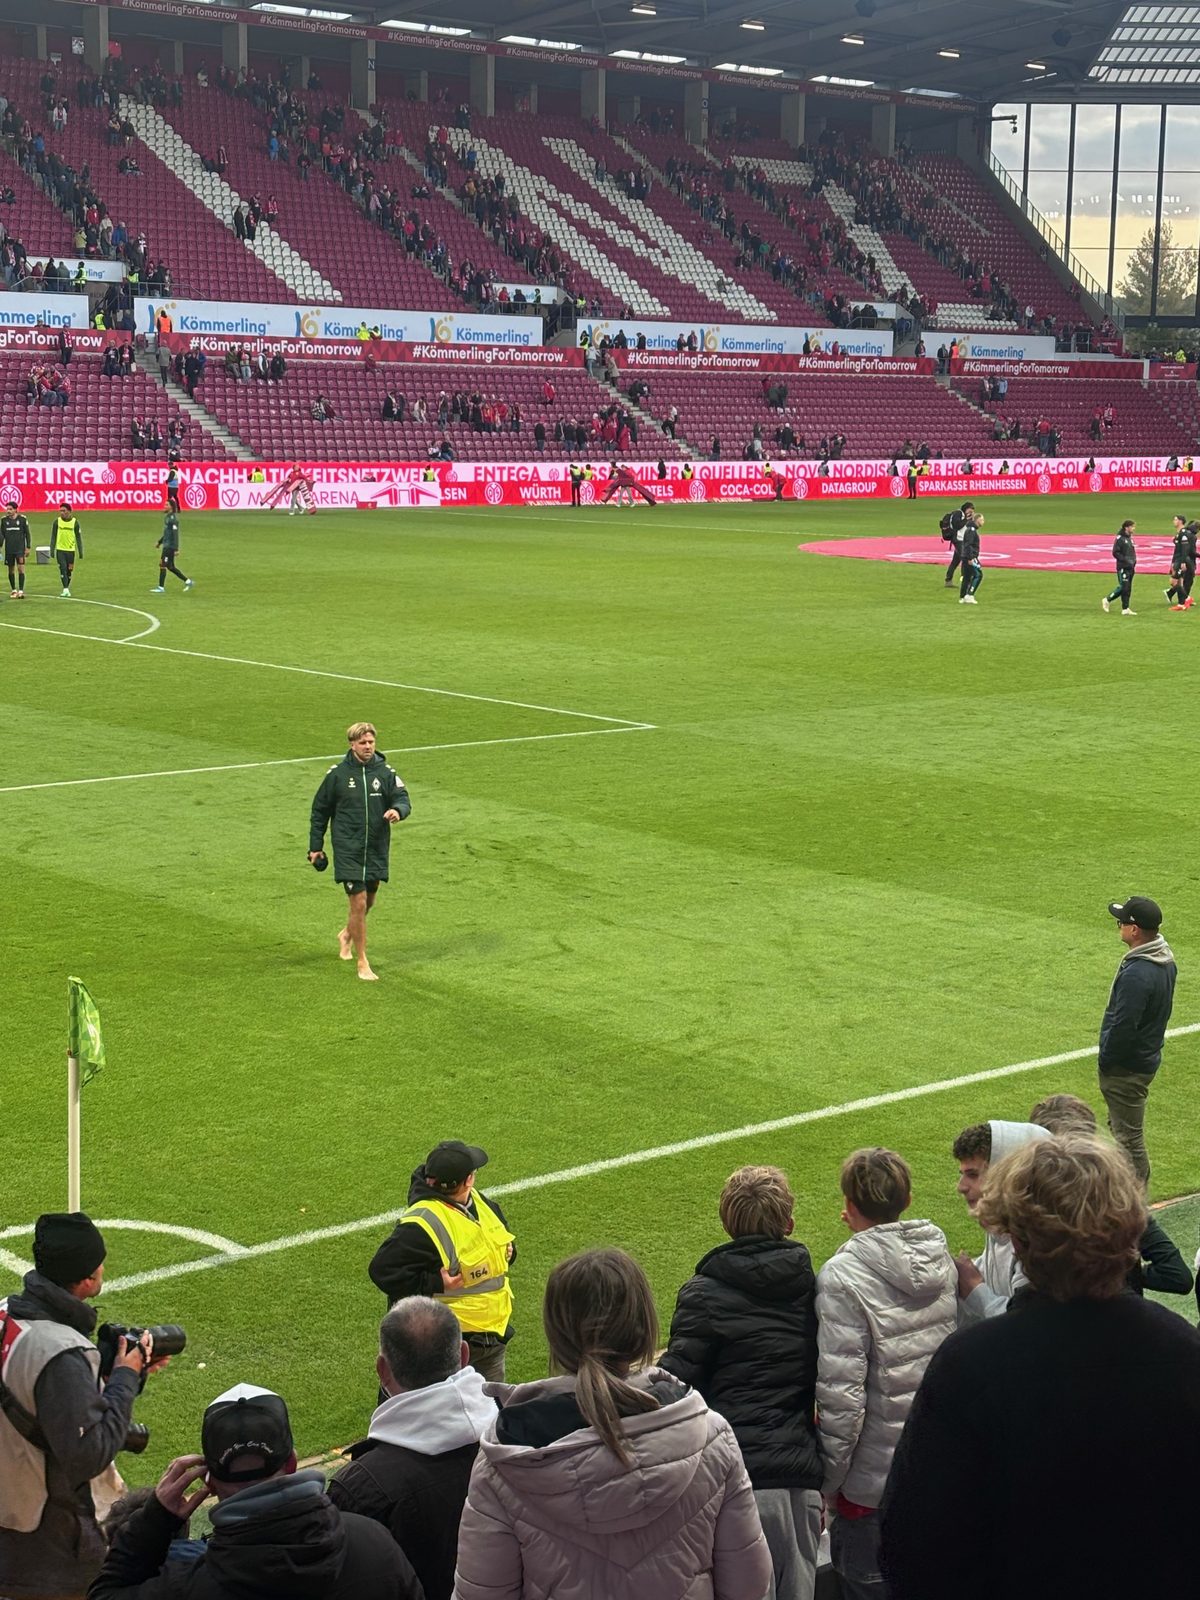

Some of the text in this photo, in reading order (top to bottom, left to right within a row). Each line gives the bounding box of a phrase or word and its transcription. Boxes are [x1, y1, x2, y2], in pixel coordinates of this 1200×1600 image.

[180, 316, 267, 335] Kömmerling
[456, 329, 530, 344] Kömmerling
[412, 345, 563, 362] #KömmerlingForTomorrow
[722, 338, 784, 356] Kömmerling
[971, 346, 1024, 359] Kömmerling
[627, 352, 759, 367] #KömmerlingForTomorrow
[799, 358, 917, 372] #KömmerlingForTomorrow
[963, 362, 1070, 375] #KömmerlingForTomorrow
[474, 466, 540, 481] ENTEGA
[822, 482, 878, 494] DATAGROUP
[919, 479, 1026, 491] SPARKASSE RHEINHESSEN
[1062, 478, 1079, 489] SVA
[1114, 475, 1194, 488] TRANS SERVICE TEAM
[45, 490, 163, 504] XPENG MOTORS
[519, 483, 561, 499] WÜRTH
[470, 1267, 488, 1280] 164
